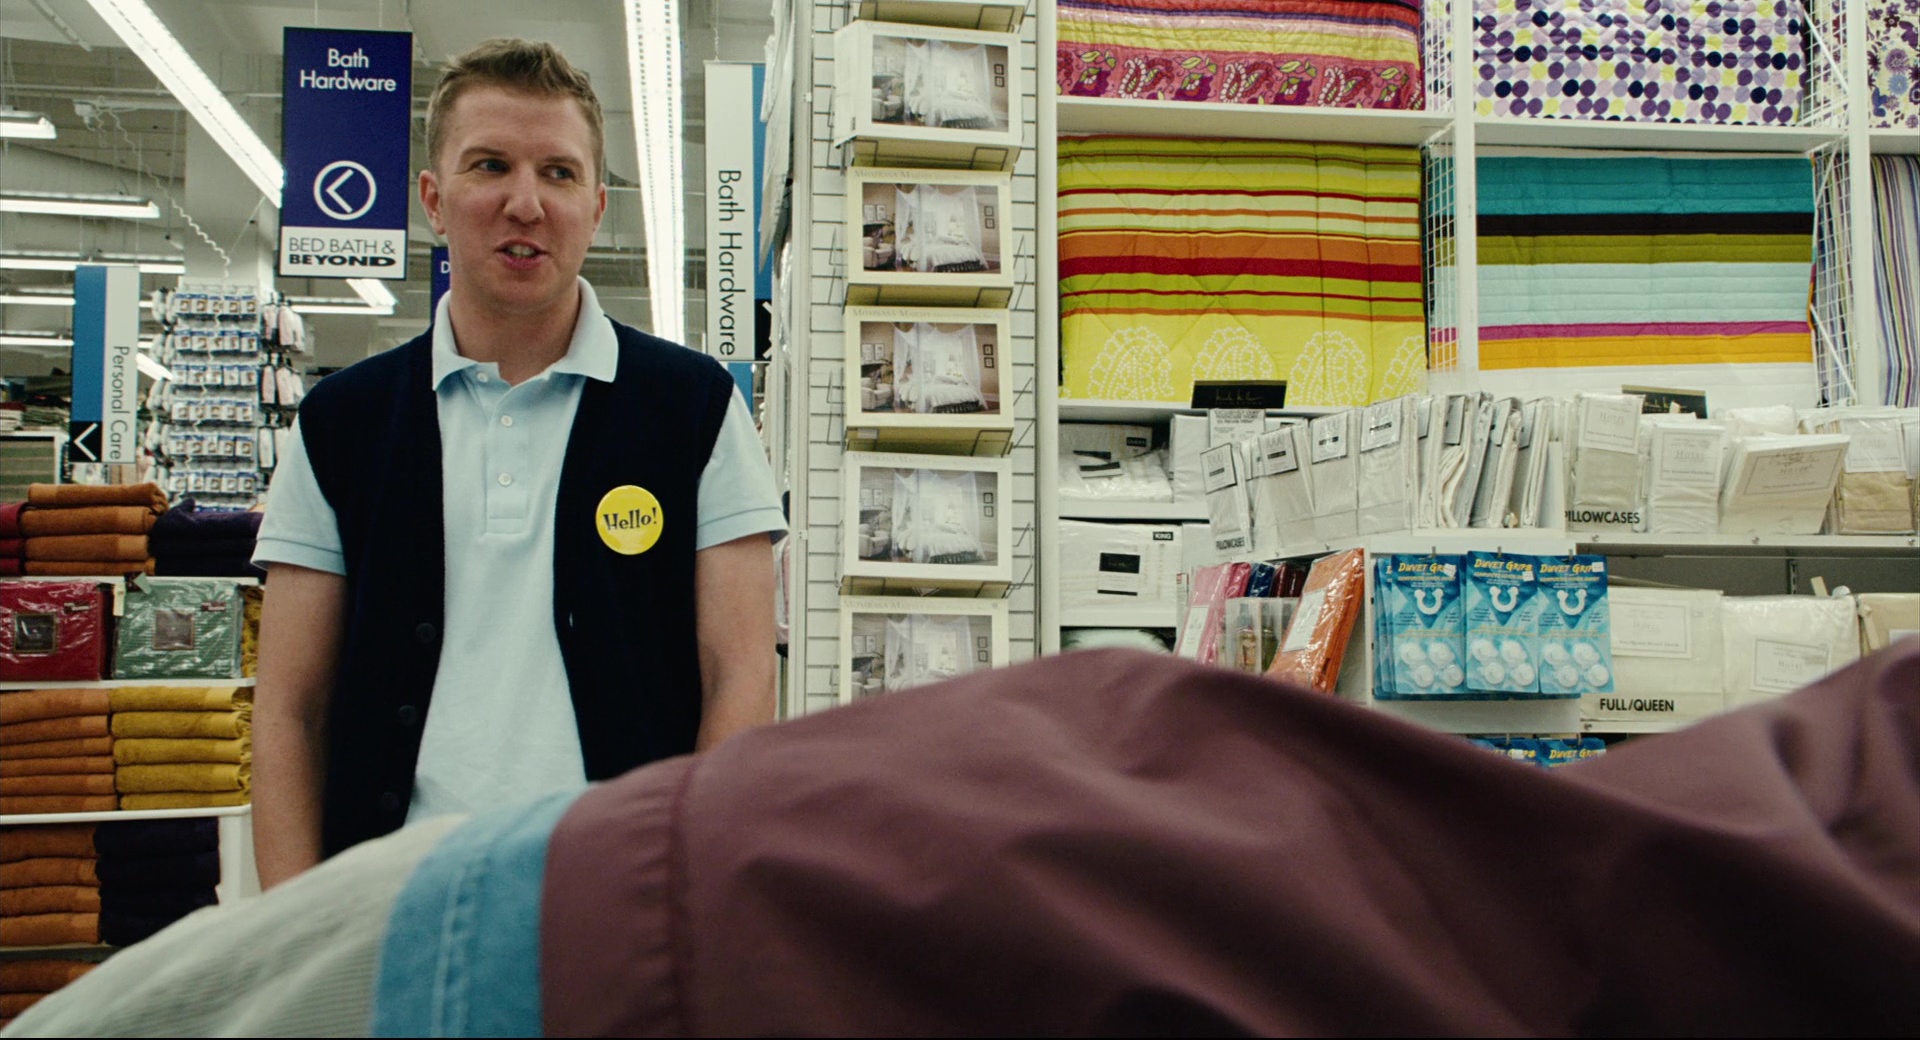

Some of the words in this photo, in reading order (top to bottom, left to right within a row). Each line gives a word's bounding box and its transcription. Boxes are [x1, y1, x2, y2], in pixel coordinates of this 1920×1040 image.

[328, 48, 369, 68] Bath
[300, 70, 396, 92] Hardware
[718, 170, 745, 221] Bath
[289, 238, 325, 252] BED
[329, 239, 378, 254] BATH
[381, 240, 396, 254] &
[289, 254, 396, 267] BEYOND
[718, 232, 746, 355] Hardware
[111, 346, 130, 414] Personal
[109, 420, 128, 460] Care
[603, 507, 657, 530] Hello!
[1600, 698, 1674, 712] FULL/QUEEN
